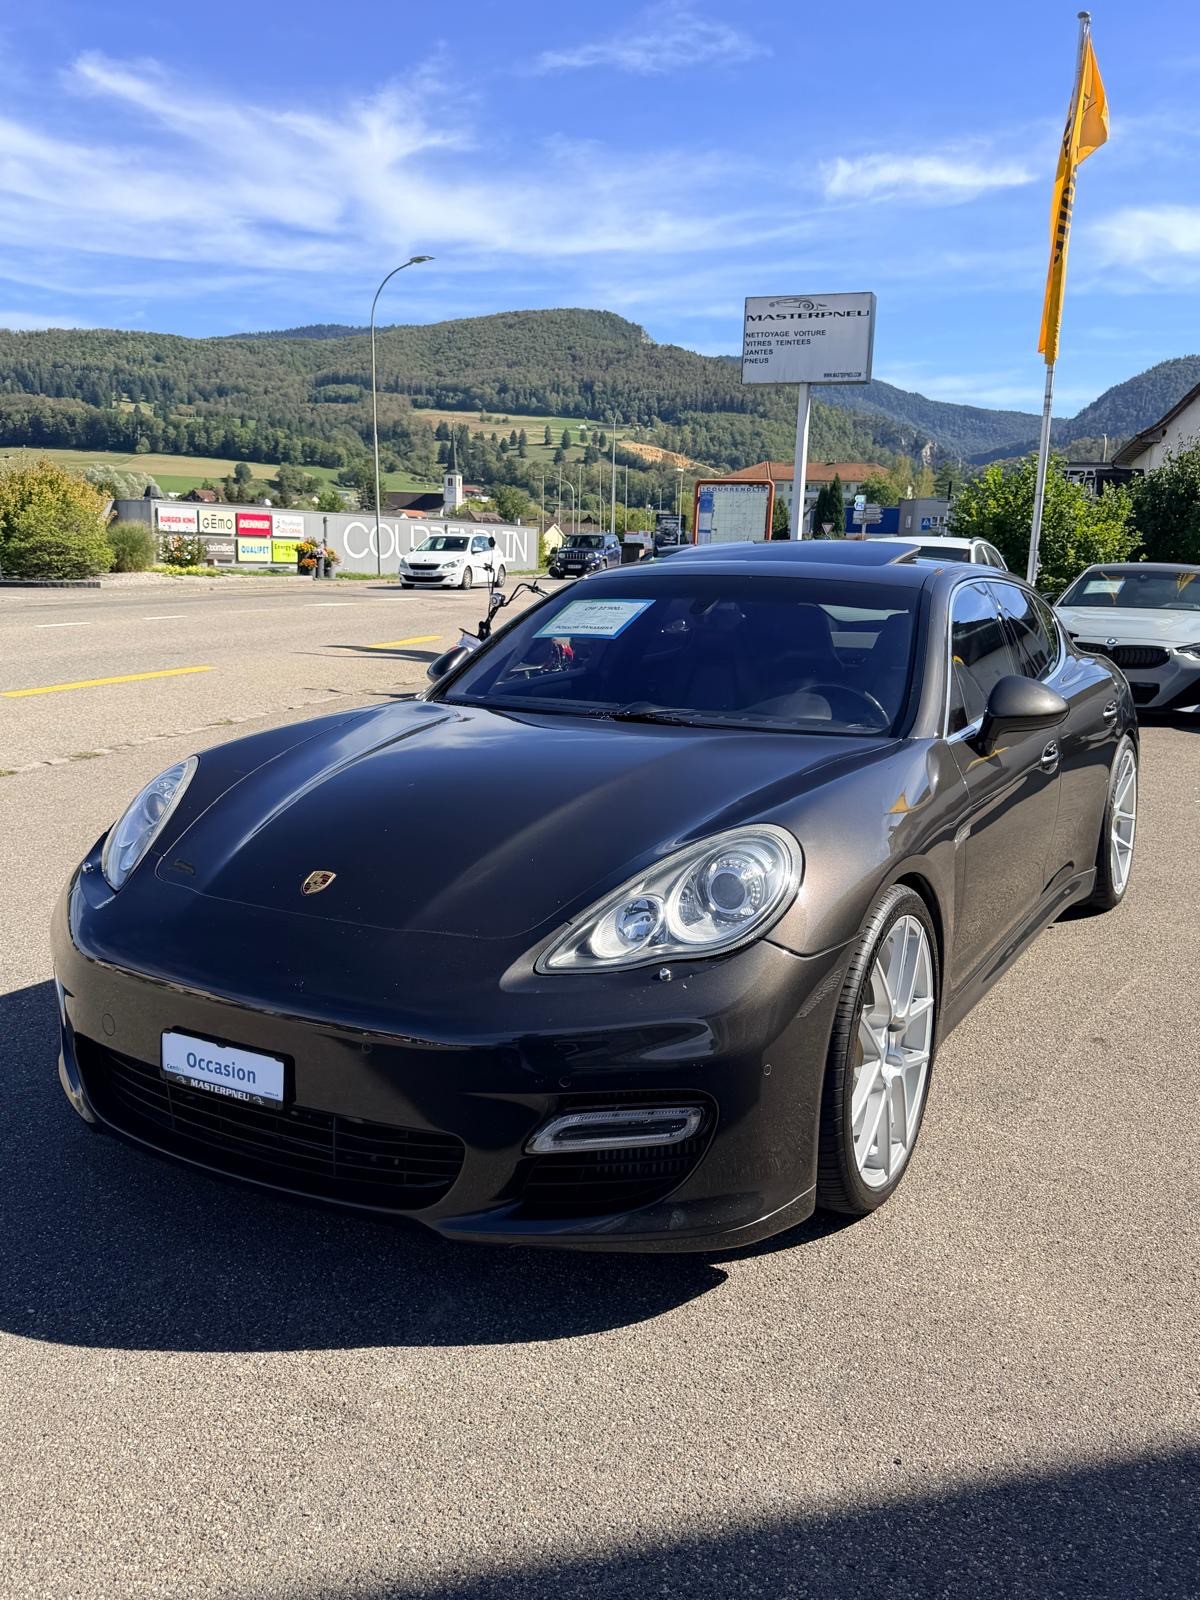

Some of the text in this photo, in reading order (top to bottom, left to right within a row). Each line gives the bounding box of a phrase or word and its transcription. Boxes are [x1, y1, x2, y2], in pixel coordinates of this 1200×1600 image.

[746, 310, 870, 322] MASTERPNEU
[239, 519, 270, 529] DENNER
[240, 545, 269, 554] QUALIPET
[186, 1052, 257, 1084] Occasion
[190, 1078, 250, 1101] MASTERPNEU
